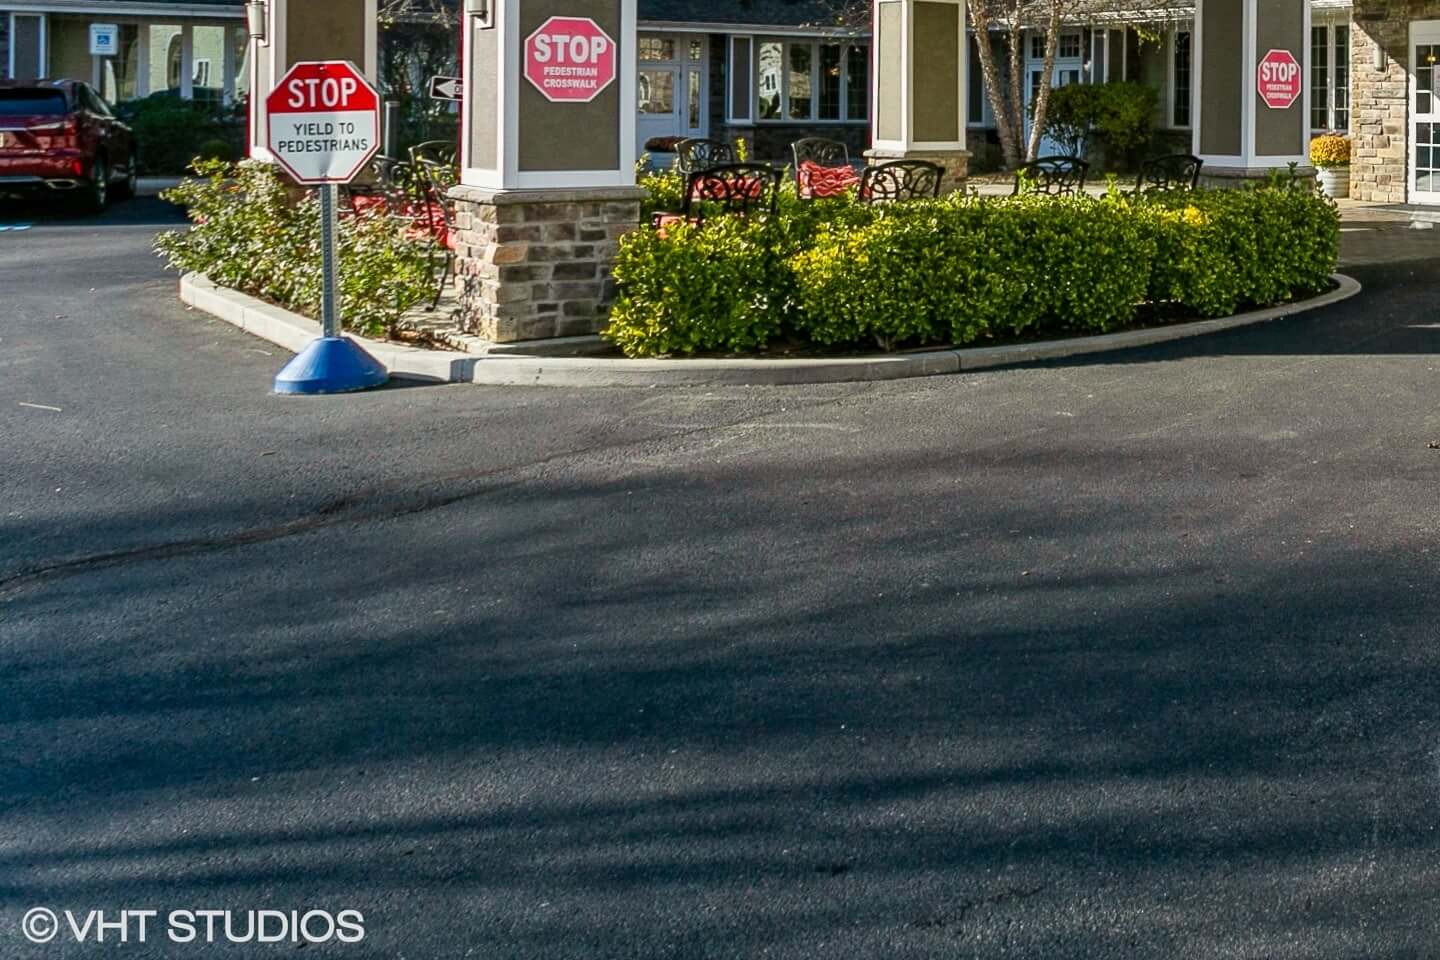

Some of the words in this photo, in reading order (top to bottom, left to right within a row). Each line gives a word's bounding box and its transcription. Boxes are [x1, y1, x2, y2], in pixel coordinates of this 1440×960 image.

[534, 34, 607, 64] STOP
[544, 67, 598, 77] PEDESTRIAN
[1262, 62, 1297, 82] STOP
[544, 79, 597, 89] CROSSWALK
[288, 78, 357, 108] STOP
[294, 123, 334, 136] YIELD
[338, 122, 355, 135] TO
[278, 139, 368, 152] PEDESTRIANS
